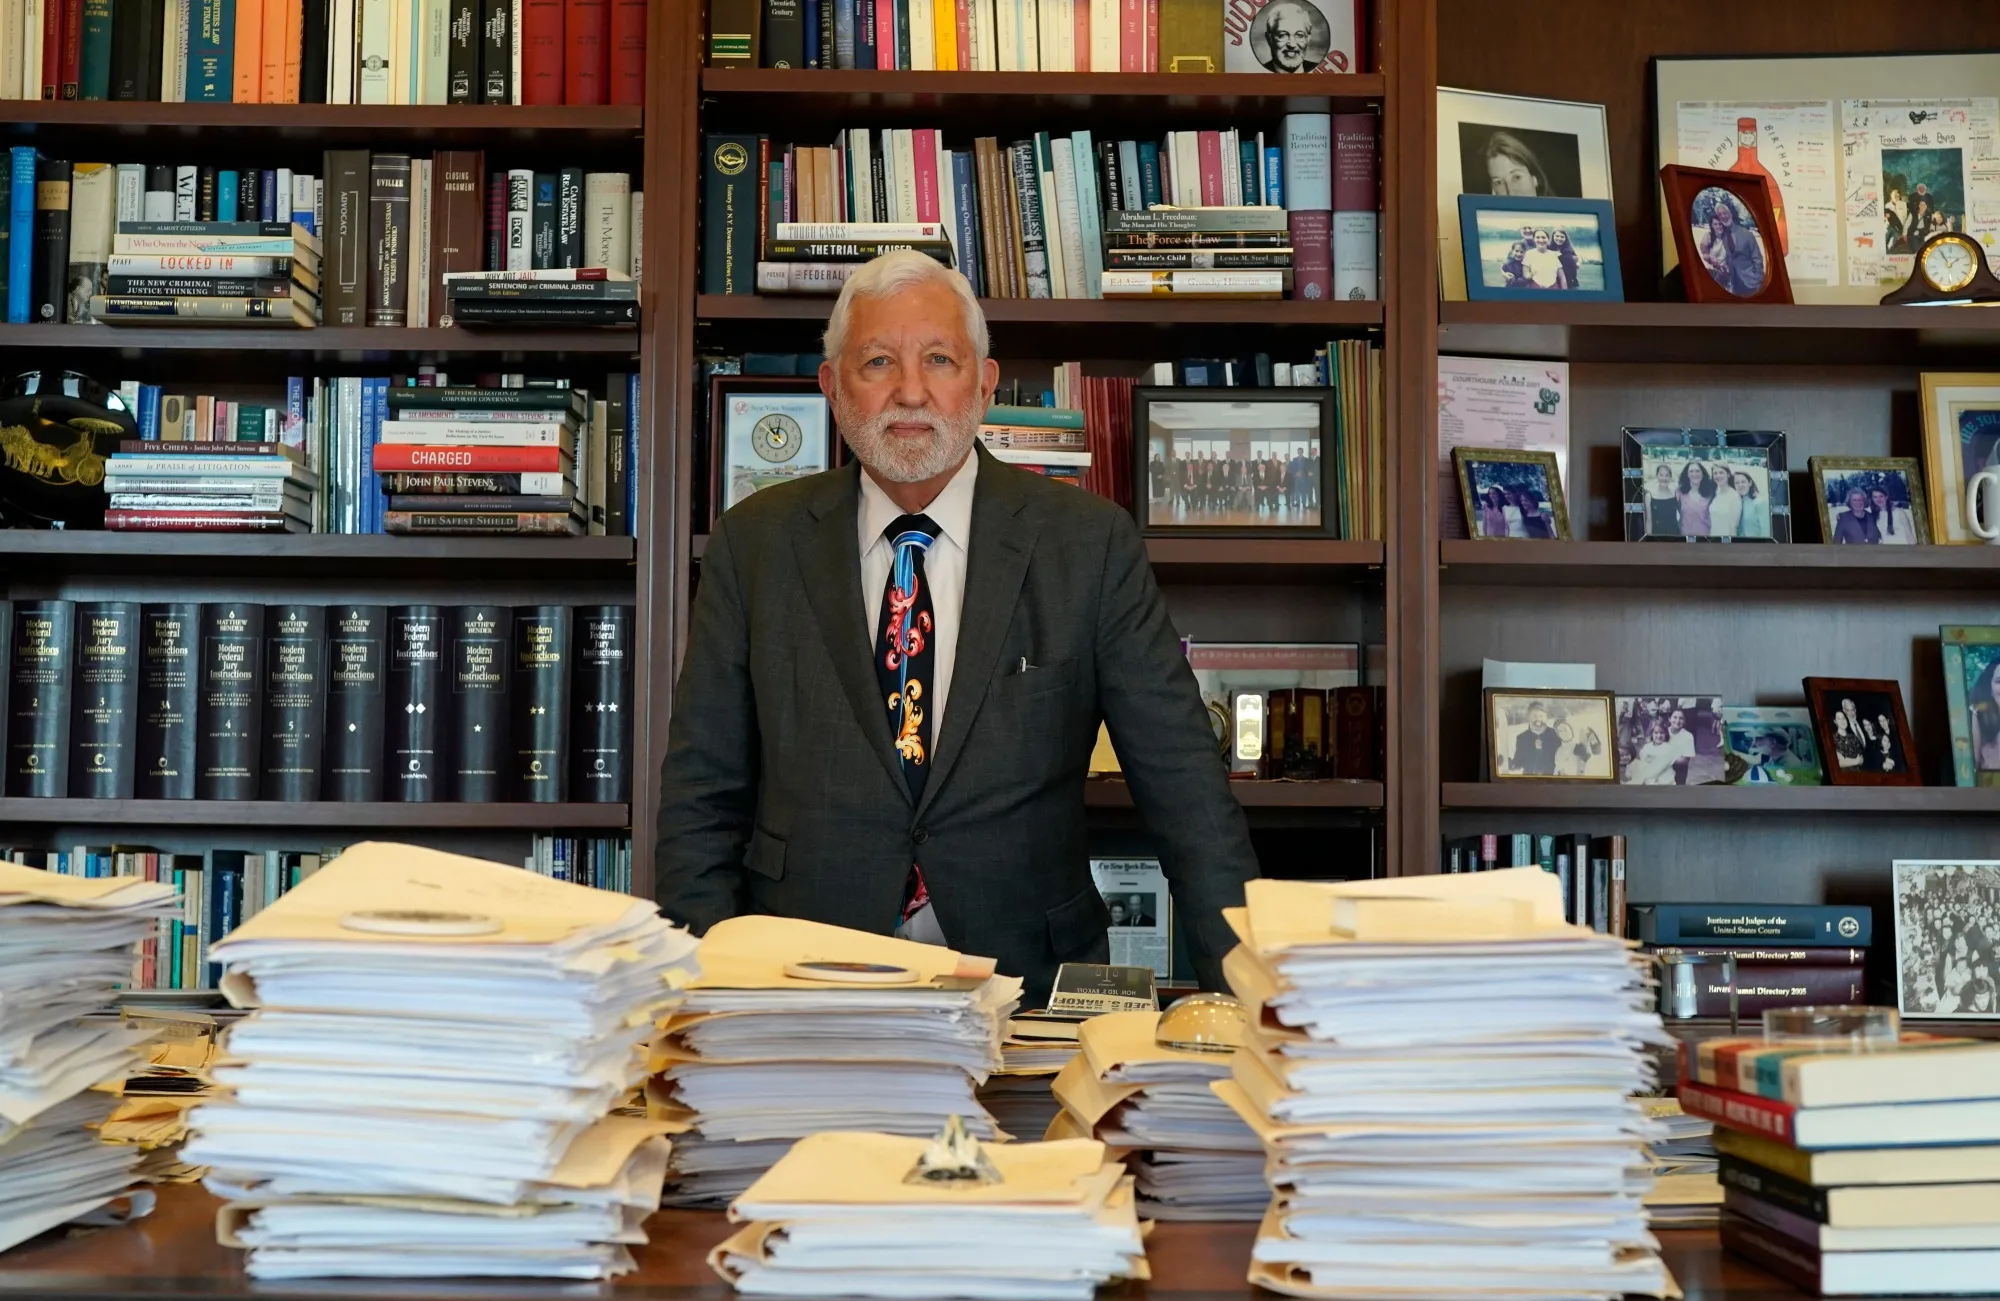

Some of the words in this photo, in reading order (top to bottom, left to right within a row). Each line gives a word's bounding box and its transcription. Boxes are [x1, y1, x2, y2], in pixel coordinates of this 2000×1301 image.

[771, 9, 794, 17] Century
[1290, 133, 1327, 141] Tradition
[1337, 133, 1375, 141] Tradition
[1878, 134, 1907, 145] Travels
[1912, 133, 1929, 143] with
[1290, 141, 1328, 149] Renewed
[1337, 142, 1375, 150] Renewed
[1708, 136, 1734, 168] HAPPY
[1764, 125, 1793, 189] BIRTHDAY
[1021, 145, 1035, 173] AFTER
[445, 171, 469, 181] CLOSING
[1108, 166, 1116, 180] END
[1145, 163, 1153, 192] COFFEE
[1245, 163, 1253, 192] COFFEE
[376, 179, 404, 188] UVILLER
[445, 183, 475, 191] ARGUMENT
[562, 174, 571, 196] REAL
[1026, 174, 1037, 191] THE
[1110, 181, 1117, 190] OF
[518, 179, 528, 210] OUTLAW
[960, 183, 968, 211] Securing
[340, 191, 348, 236] ADVOCACY
[561, 197, 571, 227] ESTATE
[569, 185, 579, 235] CALIFORNIA
[602, 205, 614, 225] The
[1028, 193, 1041, 236] MADNESS
[962, 212, 970, 225] Our
[1120, 213, 1151, 221] Abraham
[1153, 213, 1161, 221] L.
[1162, 213, 1197, 221] Freedman:
[511, 218, 522, 248] BCCI
[561, 227, 569, 245] LAW
[789, 225, 816, 239] TOUGH
[819, 225, 846, 239] CASES
[133, 239, 152, 248] Who
[153, 240, 175, 248] Owns
[176, 240, 188, 248] the
[964, 225, 972, 258] Children's
[1127, 234, 1148, 245] The
[1152, 234, 1181, 245] Force
[1185, 234, 1198, 245] of
[1199, 234, 1221, 245] Law
[599, 227, 613, 266] Money
[810, 244, 829, 255] THE
[830, 244, 859, 255] TRIAL
[877, 244, 912, 255] KAISER
[112, 258, 132, 266] PFAFF
[160, 256, 212, 270] LOCKED
[219, 256, 233, 270] IN
[966, 259, 974, 280] Future
[484, 272, 500, 280] WHY
[502, 272, 516, 280] NOT
[518, 271, 537, 280] JAIL?
[127, 279, 147, 287] THE
[149, 279, 173, 287] NEW
[175, 279, 212, 288] CRIMINAL
[127, 287, 162, 295] JUSTICE
[164, 287, 208, 295] THINKING
[363, 398, 371, 413] THE
[420, 412, 455, 420] AMENDMENTS
[362, 414, 371, 448] BUSINESS
[144, 443, 161, 451] FIVE
[162, 443, 188, 451] CHIEFS
[361, 449, 370, 477] LAWYER
[411, 451, 472, 466] CHARGED
[406, 476, 431, 487] JOHN
[433, 476, 455, 487] PAUL
[456, 476, 494, 487] STEVENS
[416, 516, 437, 525] THE
[439, 516, 474, 525] SAFEST
[479, 516, 514, 525] SHIELD
[404, 623, 430, 632] Modern
[404, 631, 429, 641] Federal
[218, 643, 245, 652] Modern
[279, 645, 306, 654] Modern
[340, 644, 368, 653] Modern
[409, 640, 424, 650] Jury
[396, 649, 438, 658] Instructions
[467, 646, 493, 655] Modern
[218, 652, 244, 661] Federal
[279, 654, 305, 663] Federal
[341, 653, 367, 662] Federal
[467, 654, 492, 663] Federal
[223, 661, 238, 671] Jury
[284, 663, 299, 673] Jury
[346, 662, 361, 671] Jury
[471, 663, 487, 673] Jury
[210, 669, 252, 679] Instructions
[272, 671, 313, 681] Instructions
[333, 670, 375, 679] Instructions
[459, 672, 500, 681] Instructions
[225, 719, 231, 729] 4
[288, 720, 294, 730] 5
[1110, 862, 1123, 870] New
[1124, 862, 1139, 871] York
[1140, 862, 1159, 870] Times
[1707, 916, 1731, 925] Justices
[1732, 916, 1744, 925] and
[1745, 916, 1766, 926] Judges
[1767, 915, 1775, 925] of
[1775, 916, 1787, 925] the
[1713, 926, 1737, 934] United
[1737, 926, 1757, 934] States
[1758, 926, 1781, 934] Courts
[1756, 951, 1789, 961] Directory
[1790, 951, 1806, 959] 2005
[1708, 985, 1731, 993] Harvard
[1756, 987, 1789, 997] Directory
[1791, 987, 1806, 995] 2005
